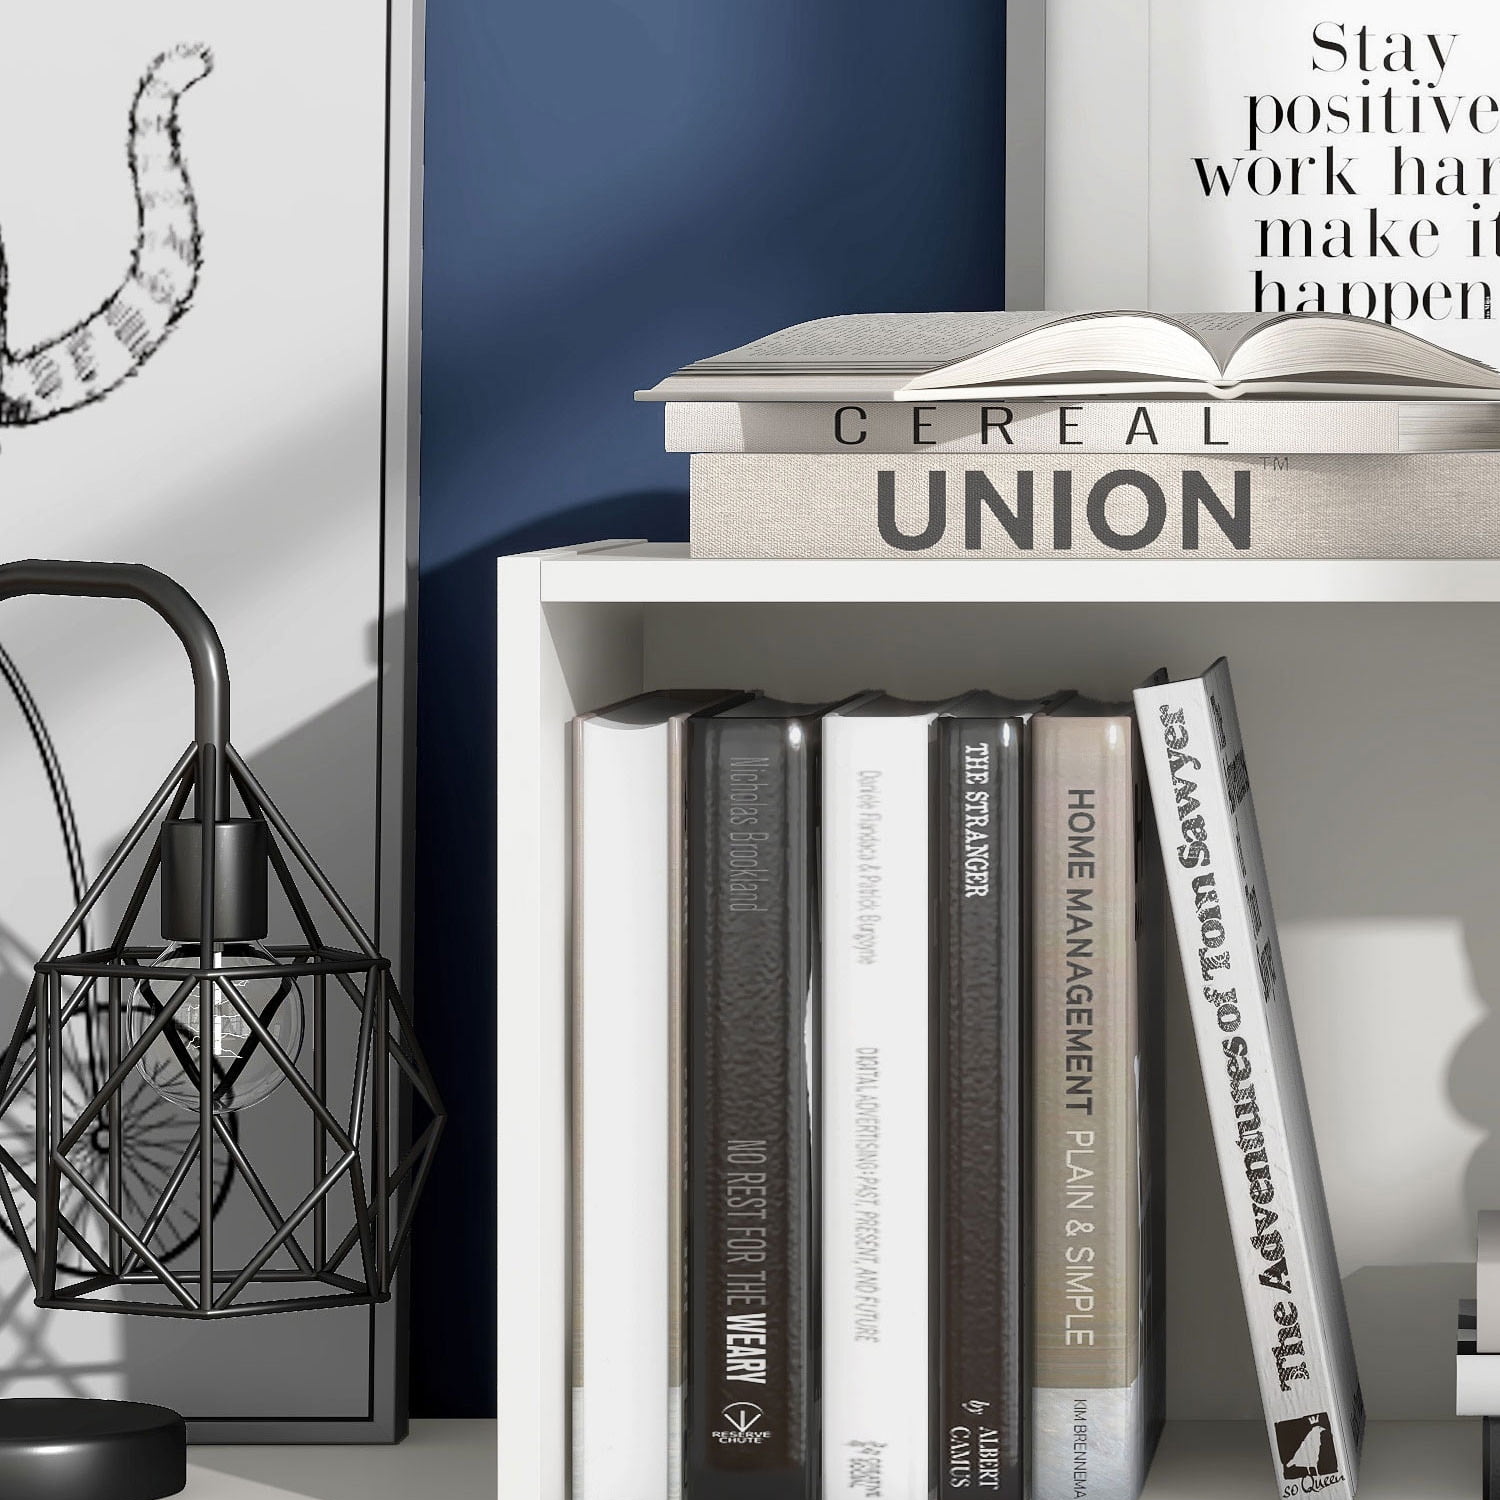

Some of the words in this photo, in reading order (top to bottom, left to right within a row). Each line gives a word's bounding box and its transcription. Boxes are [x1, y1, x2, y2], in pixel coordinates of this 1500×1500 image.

[1312, 21, 1461, 88] Stay
[1190, 146, 1360, 197] work
[1255, 208, 1440, 258] make
[834, 406, 1230, 446] CEREAL
[877, 469, 1252, 551] UNION
[729, 757, 769, 825] Nicholas
[964, 742, 990, 785] THE
[1159, 704, 1211, 870] Sawyer
[964, 791, 990, 899] STRANGER
[1067, 789, 1096, 879] HOME
[729, 832, 769, 912] Brookland
[1190, 872, 1231, 982] Tom
[1065, 888, 1095, 1116] MANAGEMENT
[1203, 985, 1242, 1033] of
[726, 1139, 766, 1165] NO
[1066, 1130, 1095, 1209] PLAIN
[1222, 1036, 1292, 1295] Adventures
[726, 1172, 766, 1217] REST
[726, 1226, 766, 1264] FOR
[1065, 1219, 1095, 1238] &
[726, 1270, 766, 1306] THE
[1065, 1246, 1095, 1346] SIMPLE
[726, 1311, 766, 1385] WEARY
[1272, 1300, 1311, 1392] The
[711, 1430, 772, 1438] RESERVE
[962, 1398, 990, 1415] by
[1072, 1399, 1088, 1421] KIM
[948, 1425, 972, 1489] CAMUS
[978, 1425, 1000, 1491] ALBERT
